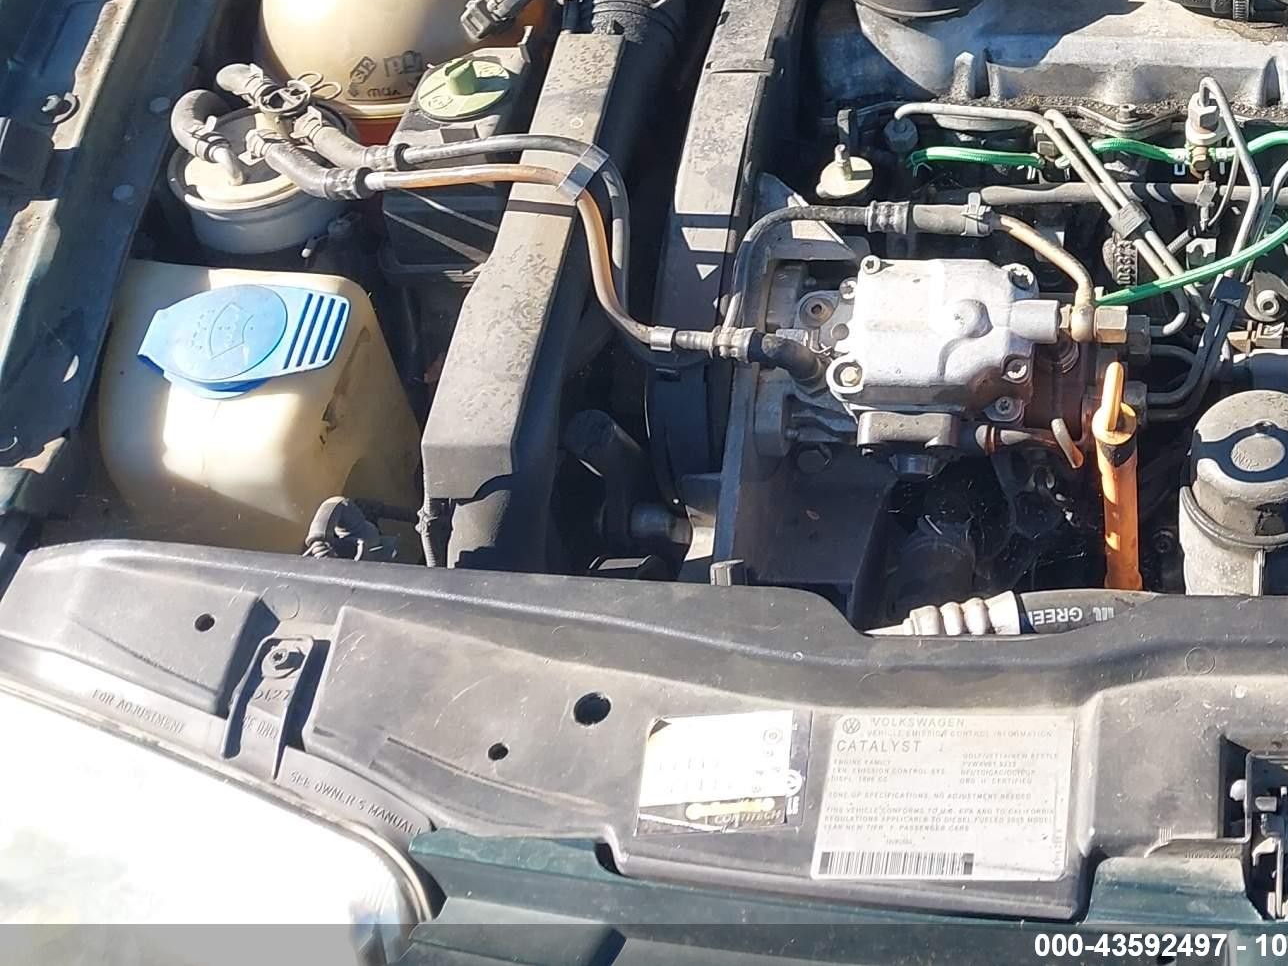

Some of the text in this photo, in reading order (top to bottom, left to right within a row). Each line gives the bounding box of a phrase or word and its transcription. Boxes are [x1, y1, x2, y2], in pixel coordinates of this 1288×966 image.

[92, 689, 186, 734] FOR ADJUSTMENT
[872, 717, 965, 728] VOLKSWAGEN
[950, 730, 991, 738] CONTROL
[993, 730, 1053, 738] INFORMATION
[836, 739, 922, 753] CATALYST
[846, 807, 879, 815] VEHICLE
[882, 807, 925, 815] CONFORMS
